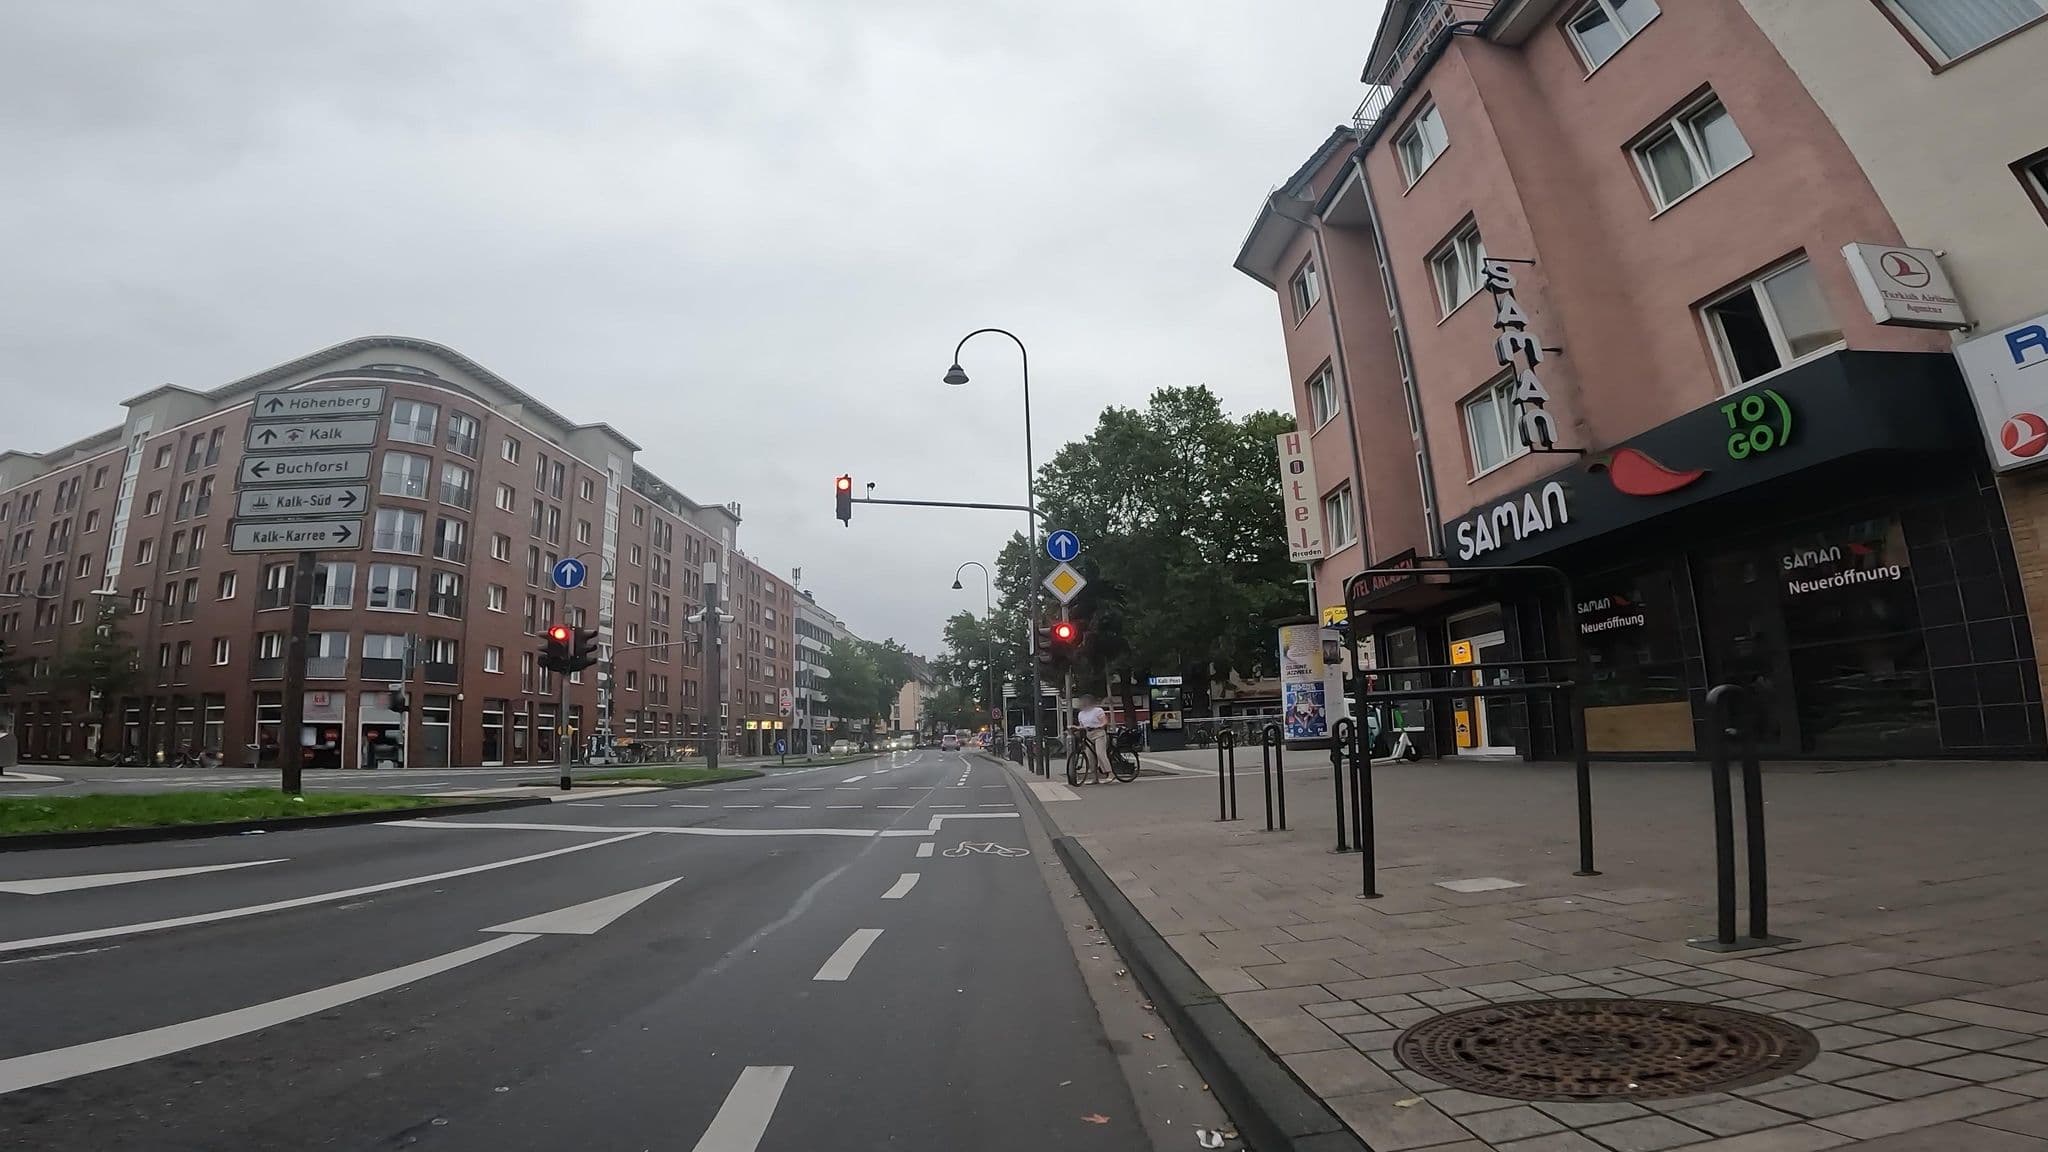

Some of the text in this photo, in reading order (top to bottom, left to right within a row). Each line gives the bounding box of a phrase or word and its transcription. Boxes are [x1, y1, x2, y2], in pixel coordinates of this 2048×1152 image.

[1881, 290, 1920, 300] Turkish
[1486, 262, 1558, 447] SAMAN
[289, 396, 371, 409] Höhenberg
[1721, 395, 1765, 429] TO
[309, 428, 342, 440] Kalk
[1728, 424, 1774, 459] GO
[275, 461, 348, 474] Buchforst
[276, 494, 331, 508] Kalk-Süd
[1286, 434, 1310, 549] Hotel
[1457, 481, 1569, 561] SAMAN
[252, 530, 326, 544] Kalk-Karree
[1783, 545, 1842, 571] SAMAN
[1788, 564, 1902, 595] Neueröffnung
[1577, 597, 1611, 614] SAMAN
[1581, 613, 1645, 635] Neueröffnung
